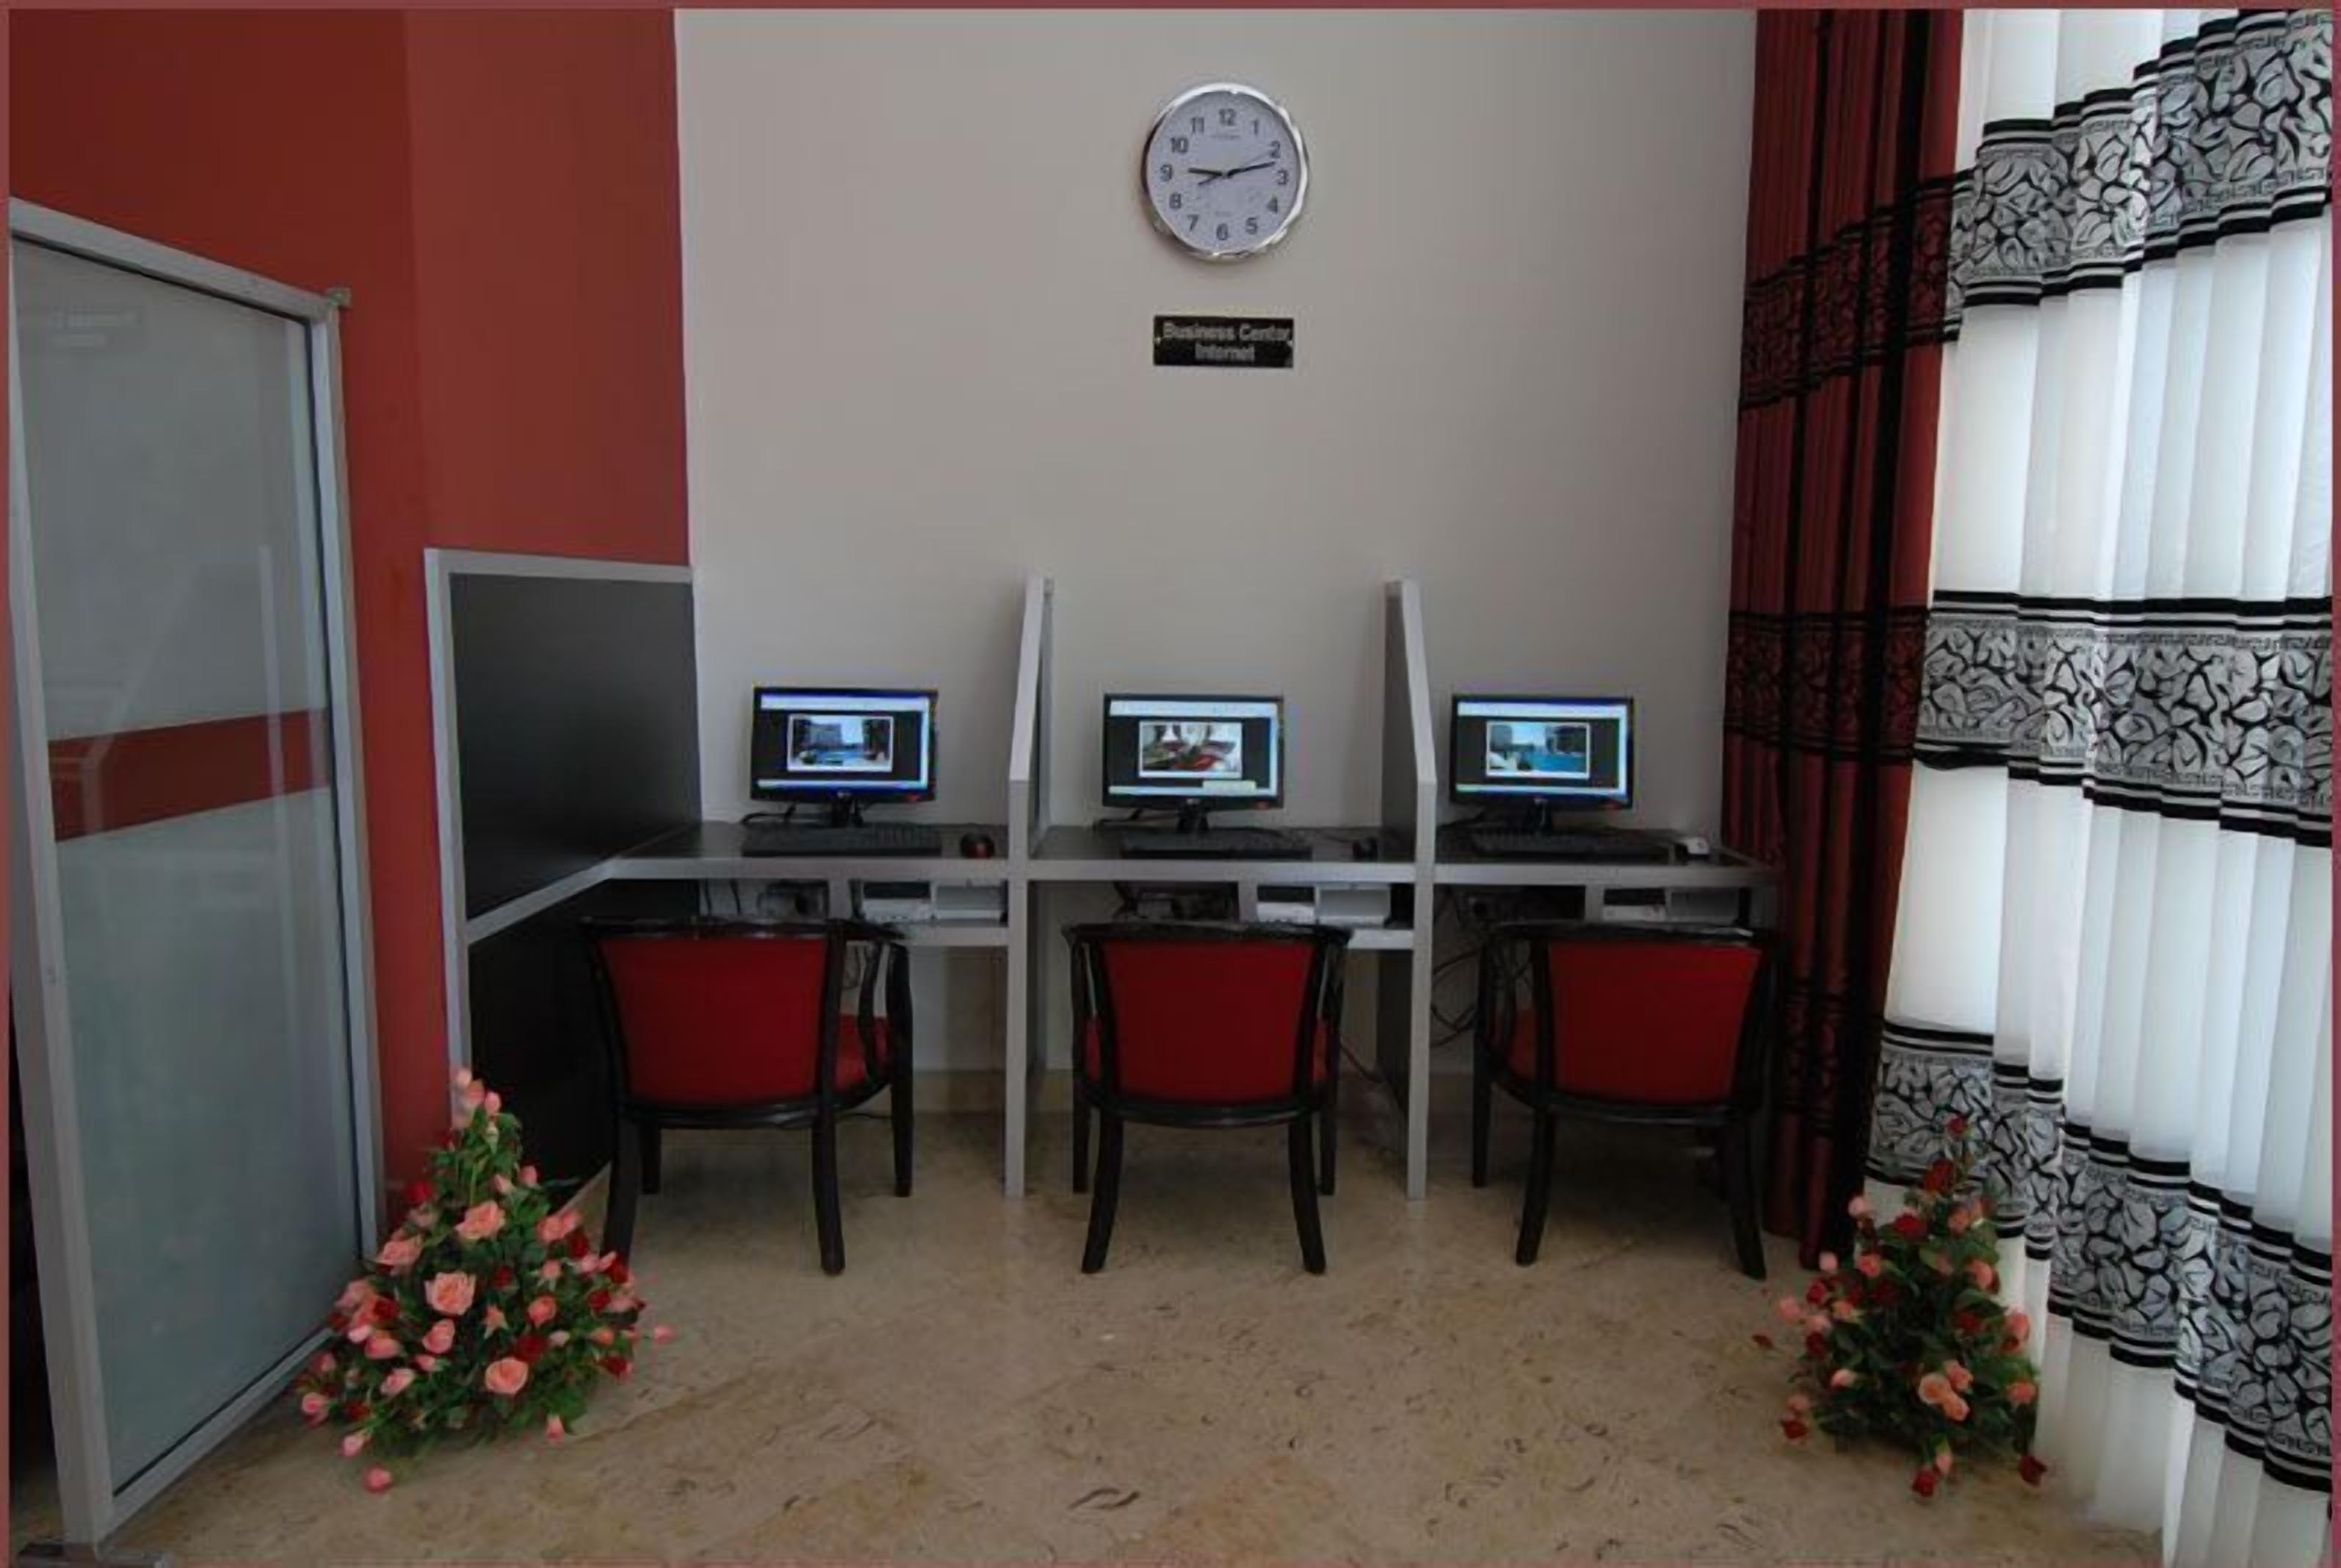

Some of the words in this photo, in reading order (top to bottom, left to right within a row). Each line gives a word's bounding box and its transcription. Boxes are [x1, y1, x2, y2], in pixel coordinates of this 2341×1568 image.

[1191, 117, 1205, 134] 11
[1219, 108, 1237, 126] 12
[1252, 118, 1260, 135] 1
[1170, 137, 1189, 153] 10
[1270, 140, 1281, 159] 2
[1160, 164, 1173, 182] 9
[1277, 169, 1289, 185] 3
[1170, 193, 1182, 209] 8
[1267, 195, 1279, 214] 4
[1187, 214, 1198, 231] 7
[1245, 217, 1259, 234] 5
[1216, 223, 1229, 241] 6
[1163, 322, 1235, 340] Business
[1195, 343, 1255, 362] Internet
